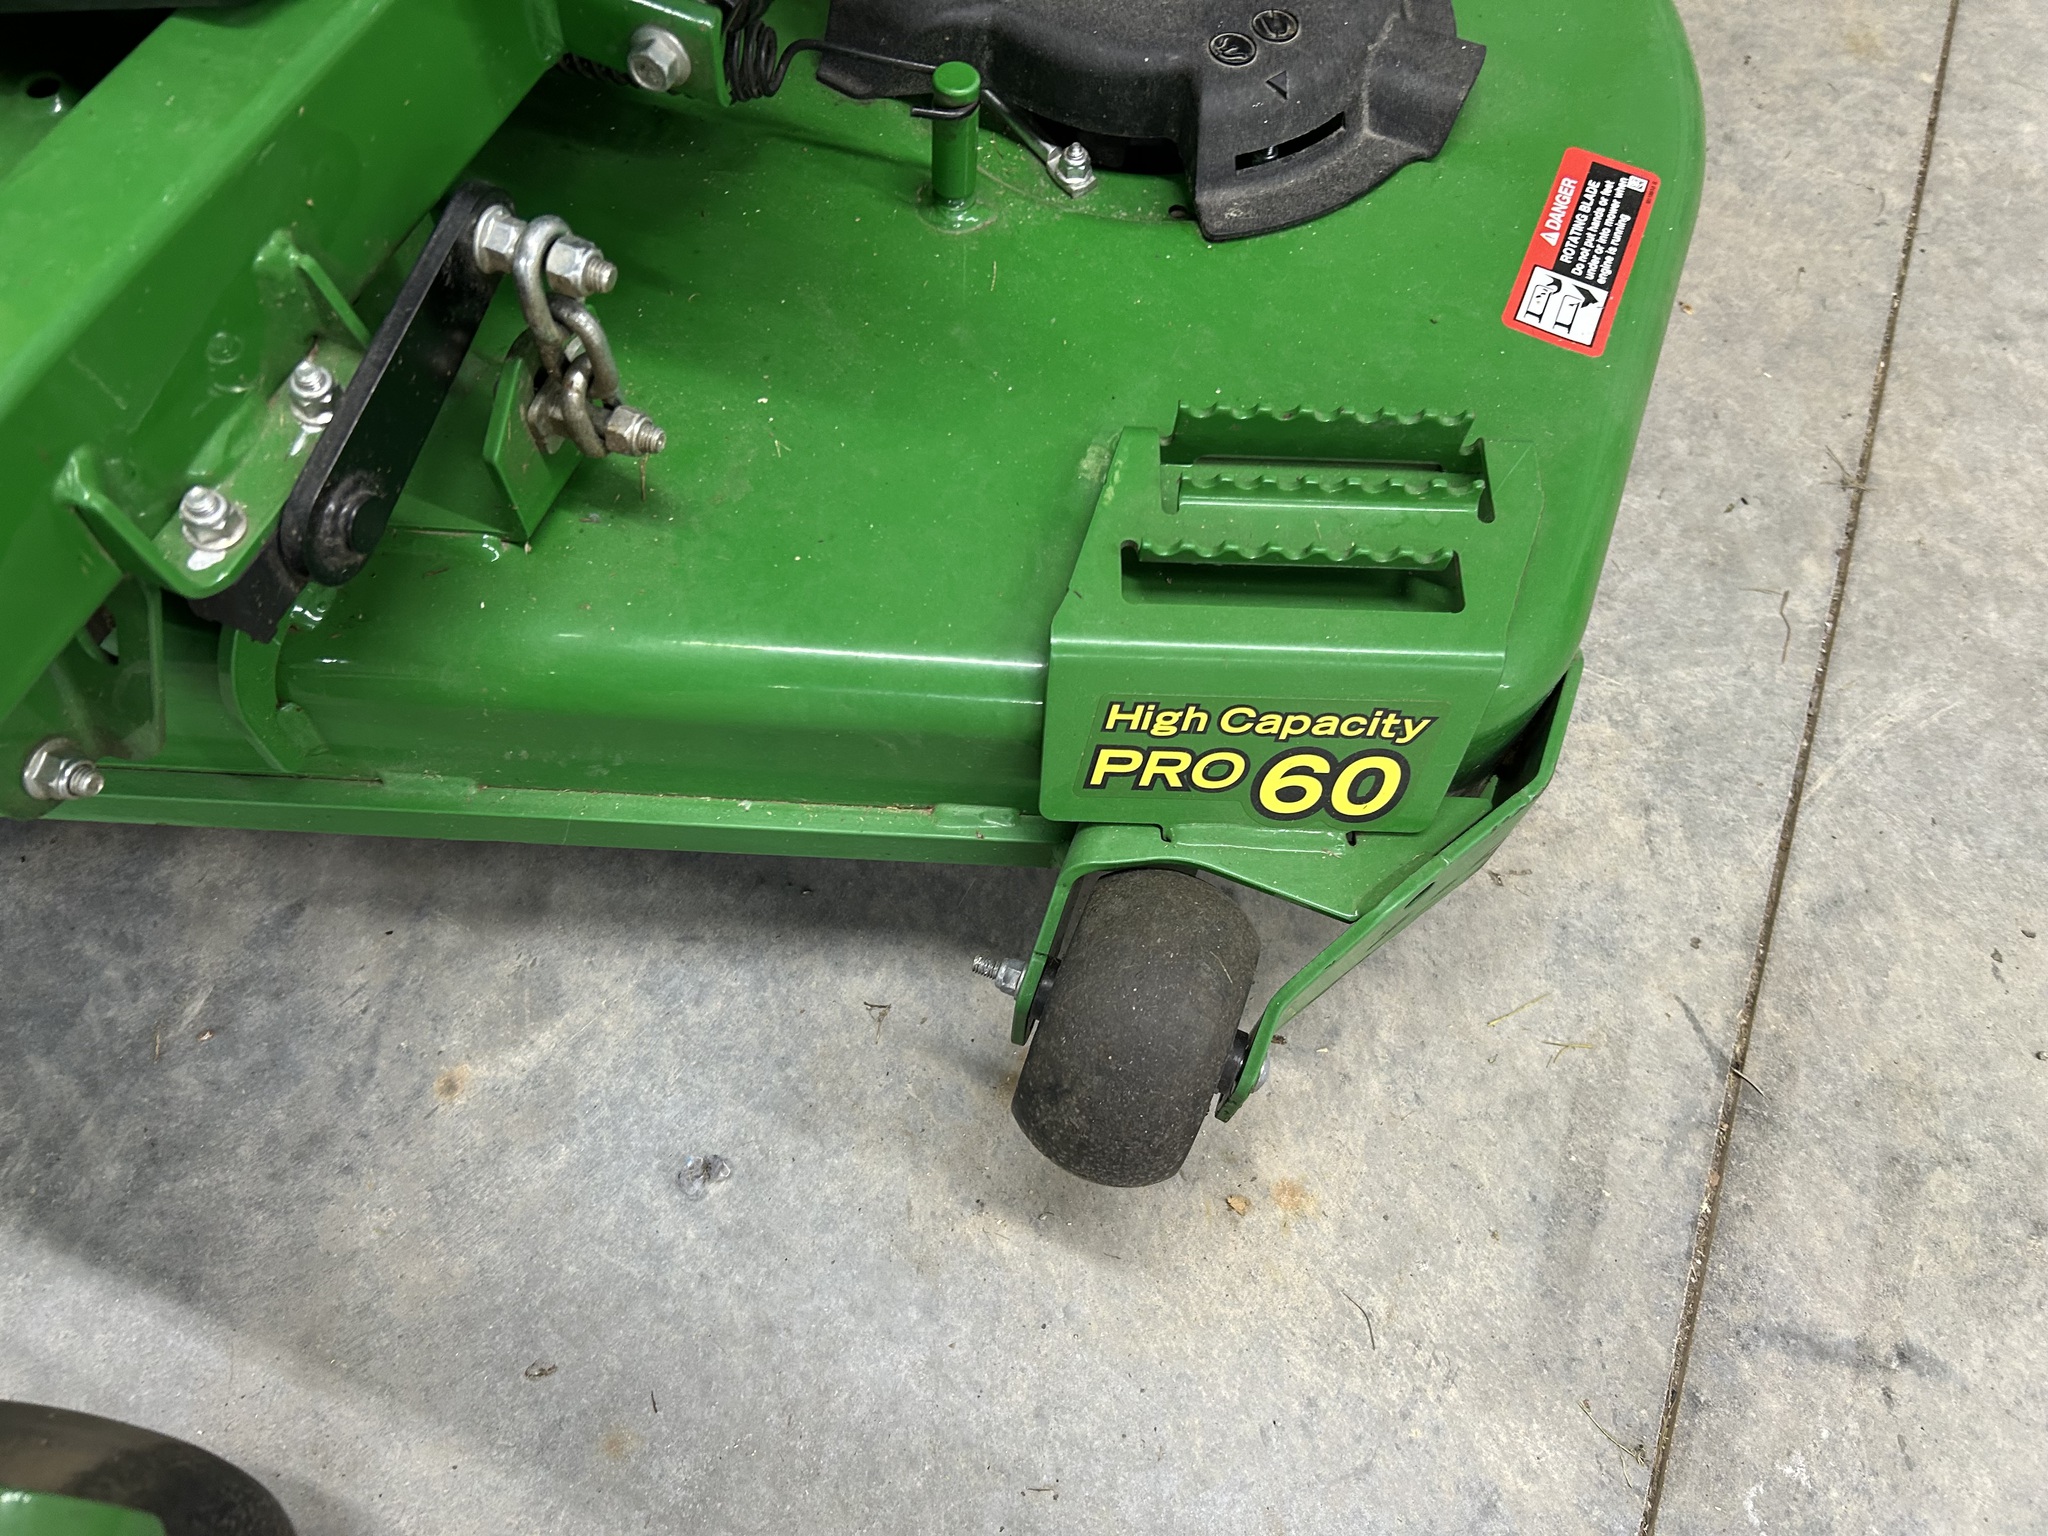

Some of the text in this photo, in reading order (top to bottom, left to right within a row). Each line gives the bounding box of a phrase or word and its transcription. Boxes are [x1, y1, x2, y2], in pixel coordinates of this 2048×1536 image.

[1600, 178, 1615, 196] feet
[1612, 176, 1629, 199] when
[1544, 176, 1578, 231] DANGER
[1605, 199, 1621, 227] mower
[1559, 178, 1601, 264] ROTATING BLADE
[1586, 206, 1605, 233] hands
[1581, 231, 1599, 248] put
[1597, 226, 1611, 244] into
[1576, 246, 1590, 262] not
[1595, 254, 1616, 286] engine
[1609, 212, 1631, 246] running
[1584, 254, 1601, 281] under
[1103, 703, 1433, 745] High Capacity
[1087, 747, 1405, 818] PRO 60
